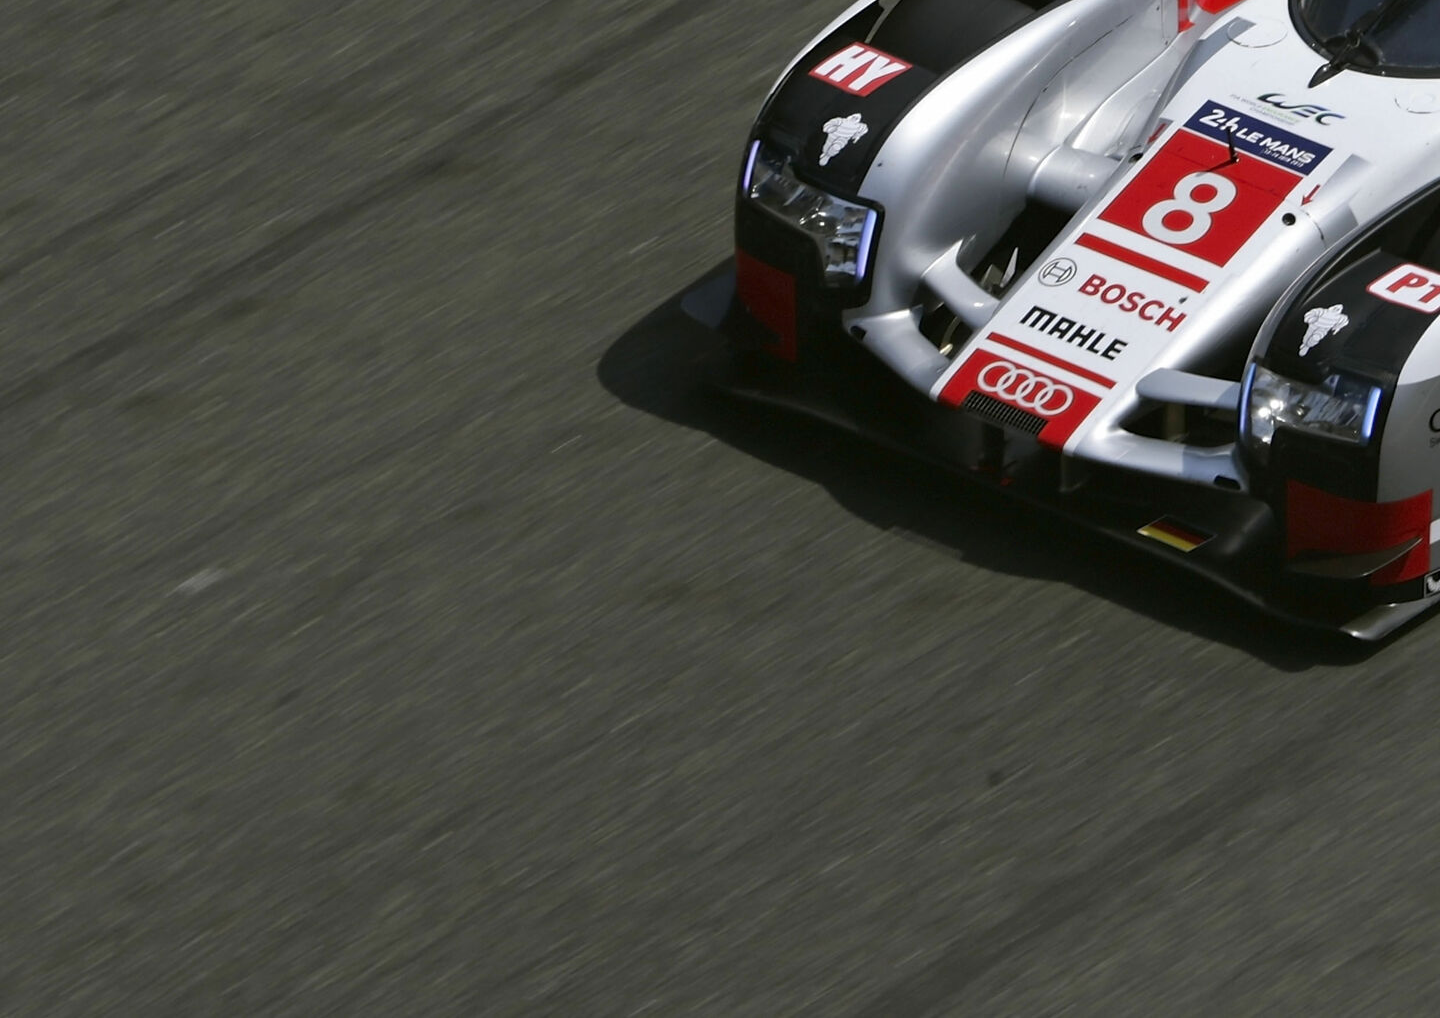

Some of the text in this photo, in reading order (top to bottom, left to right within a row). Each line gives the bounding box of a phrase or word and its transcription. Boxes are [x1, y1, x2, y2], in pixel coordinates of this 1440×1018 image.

[814, 45, 906, 91] HY
[1256, 93, 1346, 126] WEC
[1236, 127, 1264, 144] LE
[1259, 136, 1316, 165] MANS
[1142, 171, 1238, 245] 8
[1078, 274, 1188, 332] BOSCH
[1020, 305, 1129, 361] MAHLE
